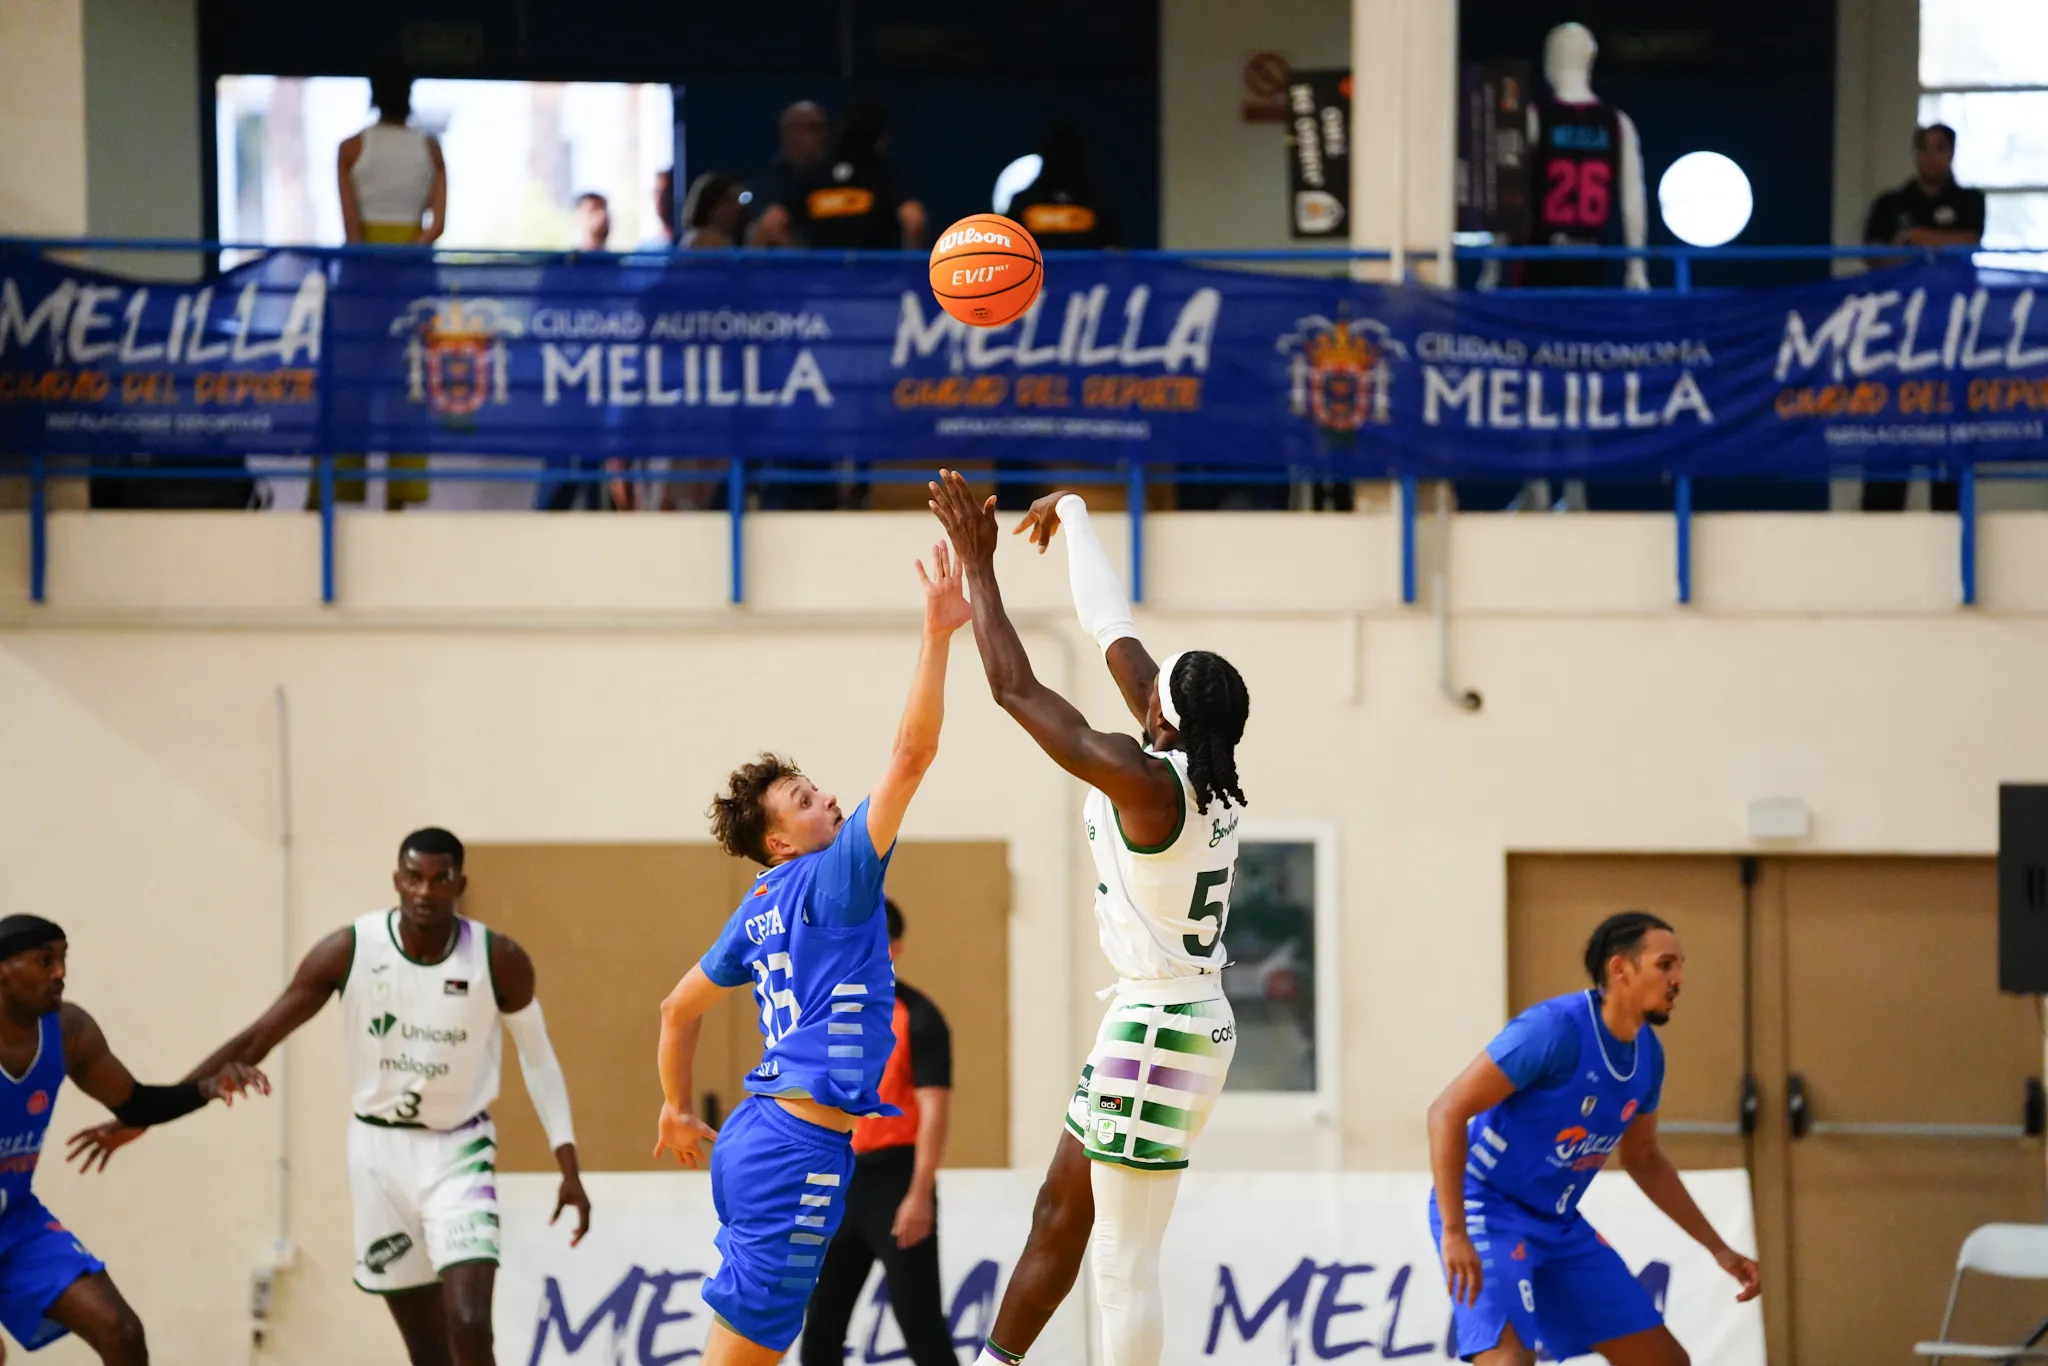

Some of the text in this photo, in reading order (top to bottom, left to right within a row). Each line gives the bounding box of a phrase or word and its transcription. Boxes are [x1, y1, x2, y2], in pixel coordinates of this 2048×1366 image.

[1544, 157, 1613, 227] 26
[939, 227, 1011, 253] Wilson
[0, 270, 326, 367] MELILLA
[531, 308, 645, 340] CIUDAD
[1415, 332, 1528, 364] CIUDAD
[123, 371, 178, 404] DEL
[194, 368, 316, 402] DEPORTE
[541, 343, 834, 407] MELILLA
[1421, 364, 1714, 429] MELILLA
[401, 1024, 467, 1047] Unicaja
[395, 1090, 422, 1121] 3
[1100, 1100, 1117, 1110] acb
